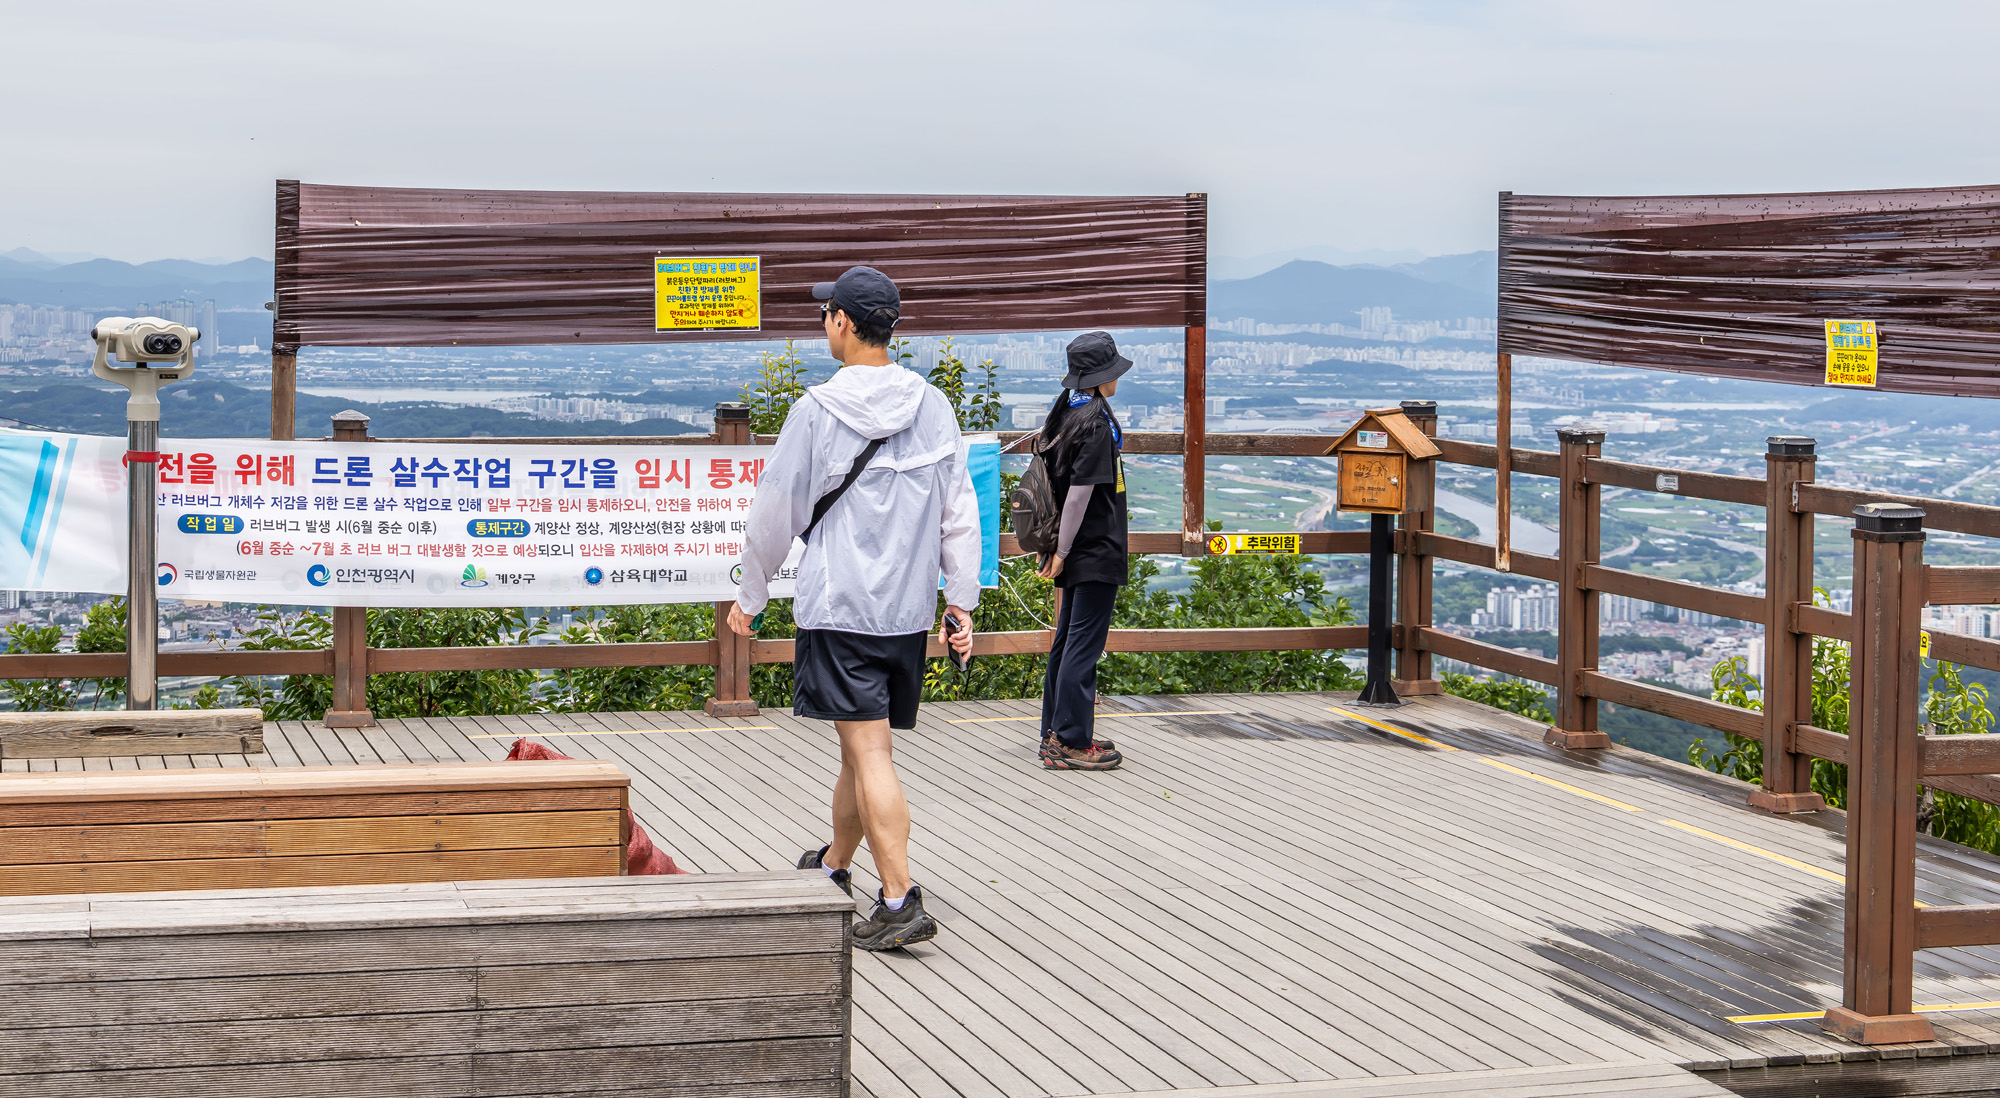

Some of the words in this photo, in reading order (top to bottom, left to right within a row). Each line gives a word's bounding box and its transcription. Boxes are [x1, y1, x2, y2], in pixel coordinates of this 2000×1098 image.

[658, 263, 690, 273] 러브버그
[692, 262, 717, 274] 친환경
[719, 263, 736, 274] 방제
[738, 262, 756, 273] 안내
[678, 286, 698, 294] 친환경
[700, 286, 720, 294] 방제를
[722, 286, 736, 294] 위한
[122, 453, 217, 485] 전을
[234, 454, 294, 486] 위해
[312, 456, 374, 487] 드론
[390, 458, 511, 488] 살수작업
[528, 458, 618, 488] 구간을
[634, 458, 692, 489] 임시
[172, 494, 222, 507] 러브버그
[228, 494, 266, 509] 개체수
[271, 496, 308, 510] 저감을
[314, 496, 338, 510] 위한
[344, 498, 368, 511] 드론
[374, 498, 398, 512] 살수
[404, 498, 452, 512] 작업으로
[458, 498, 482, 512] 인해
[488, 498, 511, 512] 일부
[516, 498, 552, 512] 구간을
[558, 498, 582, 512] 임시
[586, 498, 650, 512] 통제하오니,
[656, 498, 692, 512] 안전을
[696, 498, 732, 512] 위하여
[250, 519, 300, 532] 러브버그
[306, 520, 331, 534] 발생
[336, 520, 373, 534] 시(6월
[378, 520, 403, 534] 중순
[408, 520, 437, 535] 이후)
[475, 522, 524, 536] 통제구간
[534, 522, 571, 536] 계양산
[576, 522, 604, 536] 정상,
[609, 520, 686, 535] 계양산성(현장
[690, 520, 726, 534] 상황에
[236, 540, 264, 556] (6월
[269, 541, 294, 556] 중순
[340, 542, 352, 556] 초
[358, 543, 382, 556] 러브
[388, 543, 412, 556] 버그
[418, 544, 466, 557] 대발생할
[472, 544, 508, 557] 것으로
[514, 544, 574, 558] 예상되오니
[580, 544, 616, 557] 입산을
[621, 543, 669, 557] 자제하여
[674, 542, 710, 556] 주시기
[1248, 536, 1295, 549] 추락위험
[184, 569, 257, 581] 국립생물자원관
[336, 568, 414, 584] 인천광역시
[495, 573, 536, 584] 계양구
[610, 568, 688, 582] 삼육대학교
